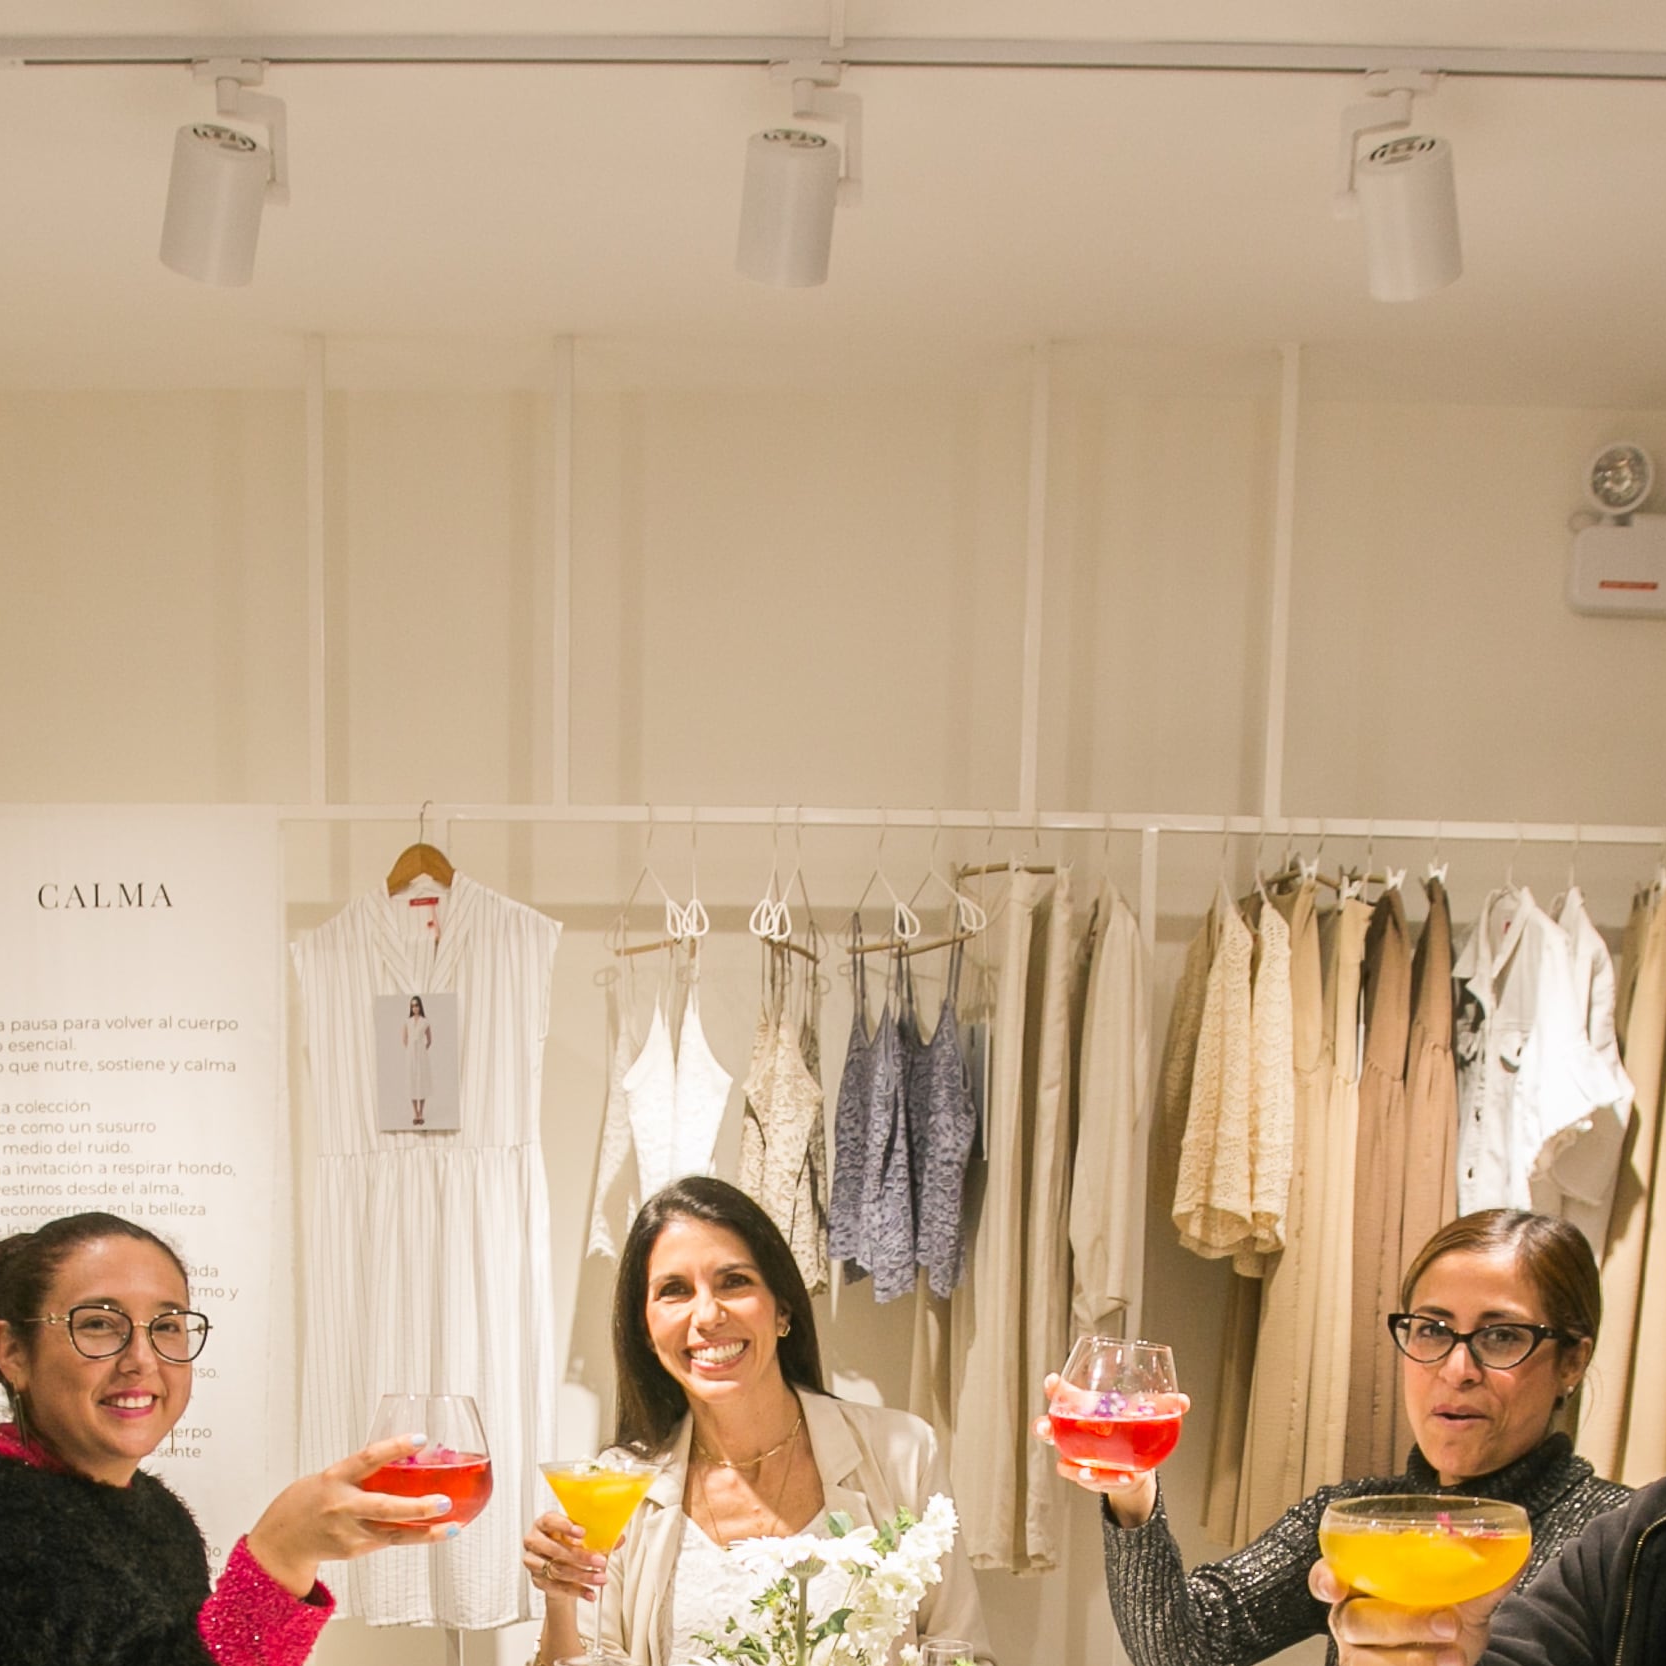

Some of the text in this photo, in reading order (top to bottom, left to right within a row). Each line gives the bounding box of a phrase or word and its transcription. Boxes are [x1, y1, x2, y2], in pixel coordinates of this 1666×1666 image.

[37, 882, 173, 910] CALMA
[11, 1019, 58, 1034] pausa
[64, 1018, 100, 1032] para
[105, 1015, 152, 1029] volver
[158, 1015, 172, 1029] al
[178, 1018, 239, 1032] cuerpo
[8, 1037, 77, 1052] esencial.
[9, 1061, 40, 1075] que
[44, 1059, 94, 1073] nutre,
[97, 1058, 165, 1072] sostiene
[170, 1061, 180, 1075] y
[184, 1058, 237, 1072] calma
[15, 1099, 91, 1114] colección
[20, 1123, 65, 1134] como
[70, 1122, 91, 1133] un
[96, 1122, 156, 1133] susurro
[2, 1142, 53, 1155] medio
[57, 1141, 82, 1154] del
[17, 1160, 93, 1175] invitación
[98, 1164, 107, 1174] a
[113, 1162, 171, 1175] respirar
[178, 1162, 236, 1176] hondo,
[67, 1181, 118, 1195] desde
[122, 1181, 134, 1194] el
[139, 1181, 184, 1196] alma,
[131, 1203, 144, 1215] la
[149, 1202, 206, 1216] belleza
[229, 1288, 239, 1301] y
